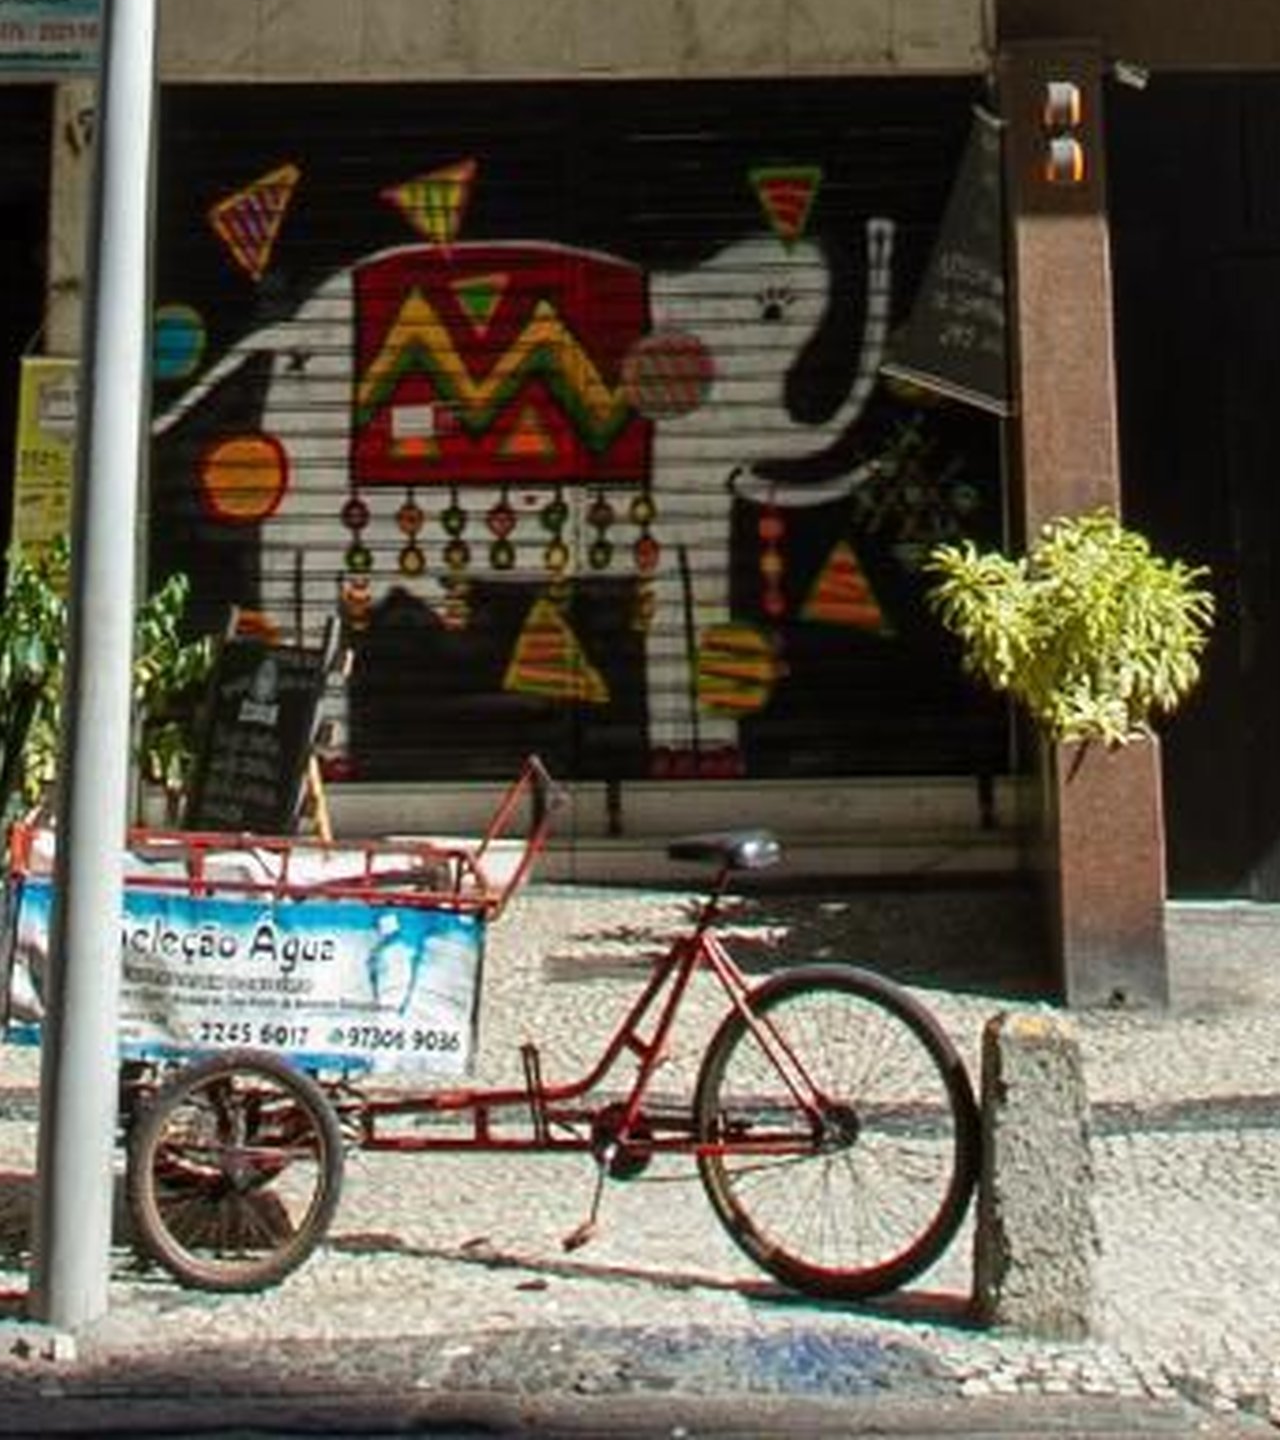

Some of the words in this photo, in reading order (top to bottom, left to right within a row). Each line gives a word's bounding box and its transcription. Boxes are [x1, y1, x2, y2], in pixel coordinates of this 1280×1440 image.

[249, 913, 337, 973] Água
[200, 1021, 251, 1044] 2245
[411, 1029, 461, 1051] 9036
